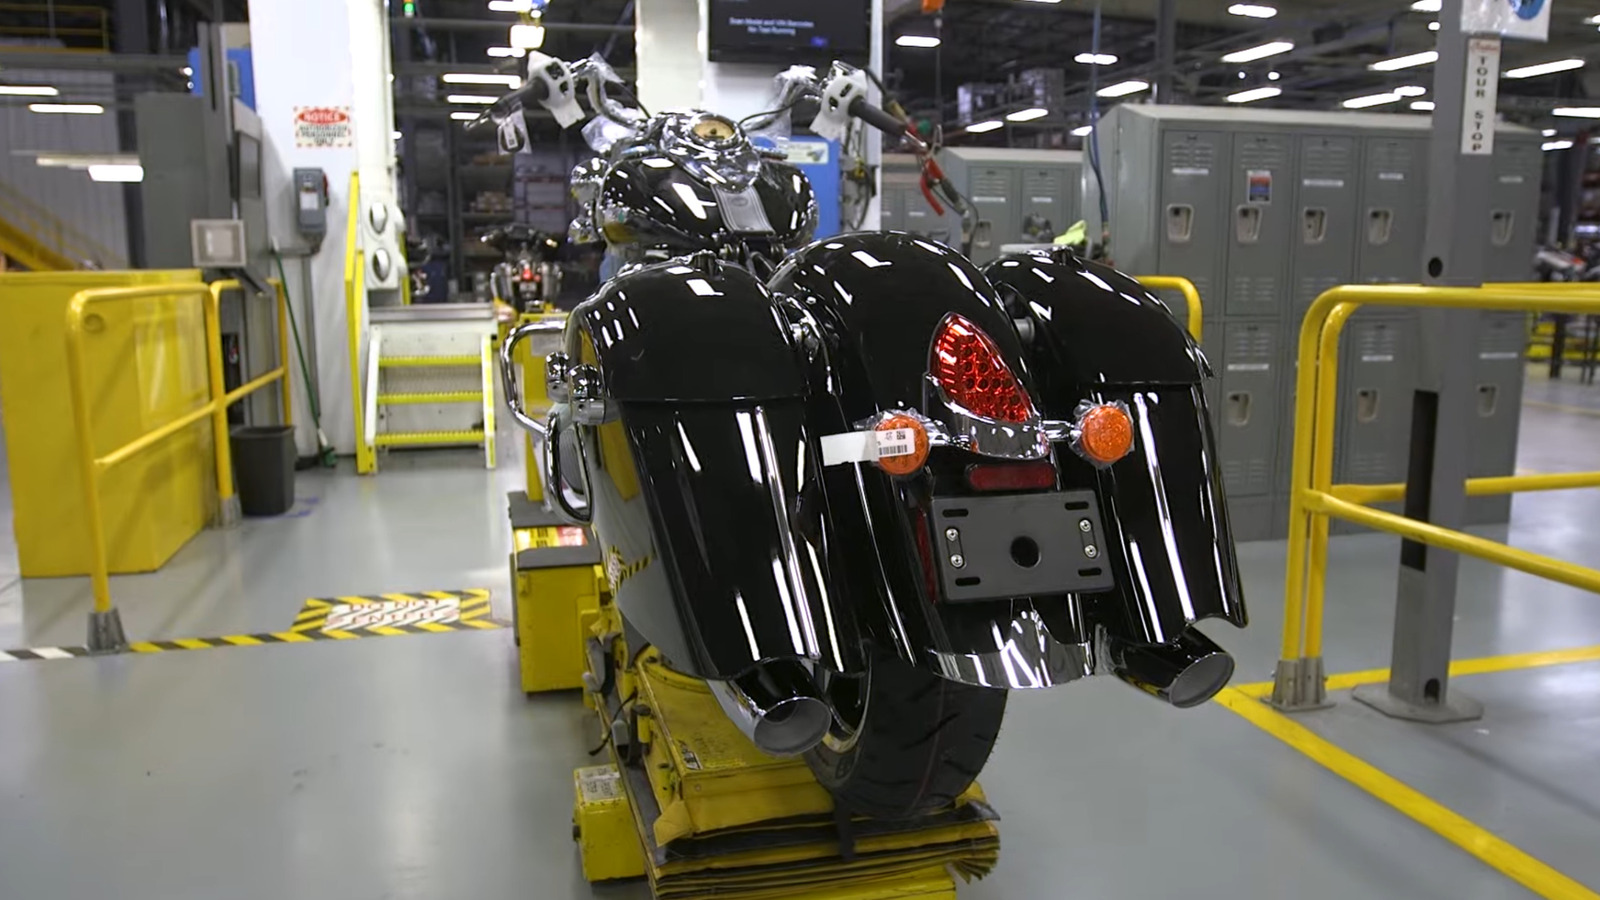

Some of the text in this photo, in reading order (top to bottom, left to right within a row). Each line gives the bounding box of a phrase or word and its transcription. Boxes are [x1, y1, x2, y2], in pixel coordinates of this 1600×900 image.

[764, 18, 775, 26] and
[1476, 55, 1488, 98] TOUR
[303, 111, 341, 122] NOTICE
[301, 130, 346, 138] PERSONNEL
[1471, 110, 1484, 151] STOP
[350, 599, 440, 611] DO NOT
[352, 611, 435, 624] ENTER
